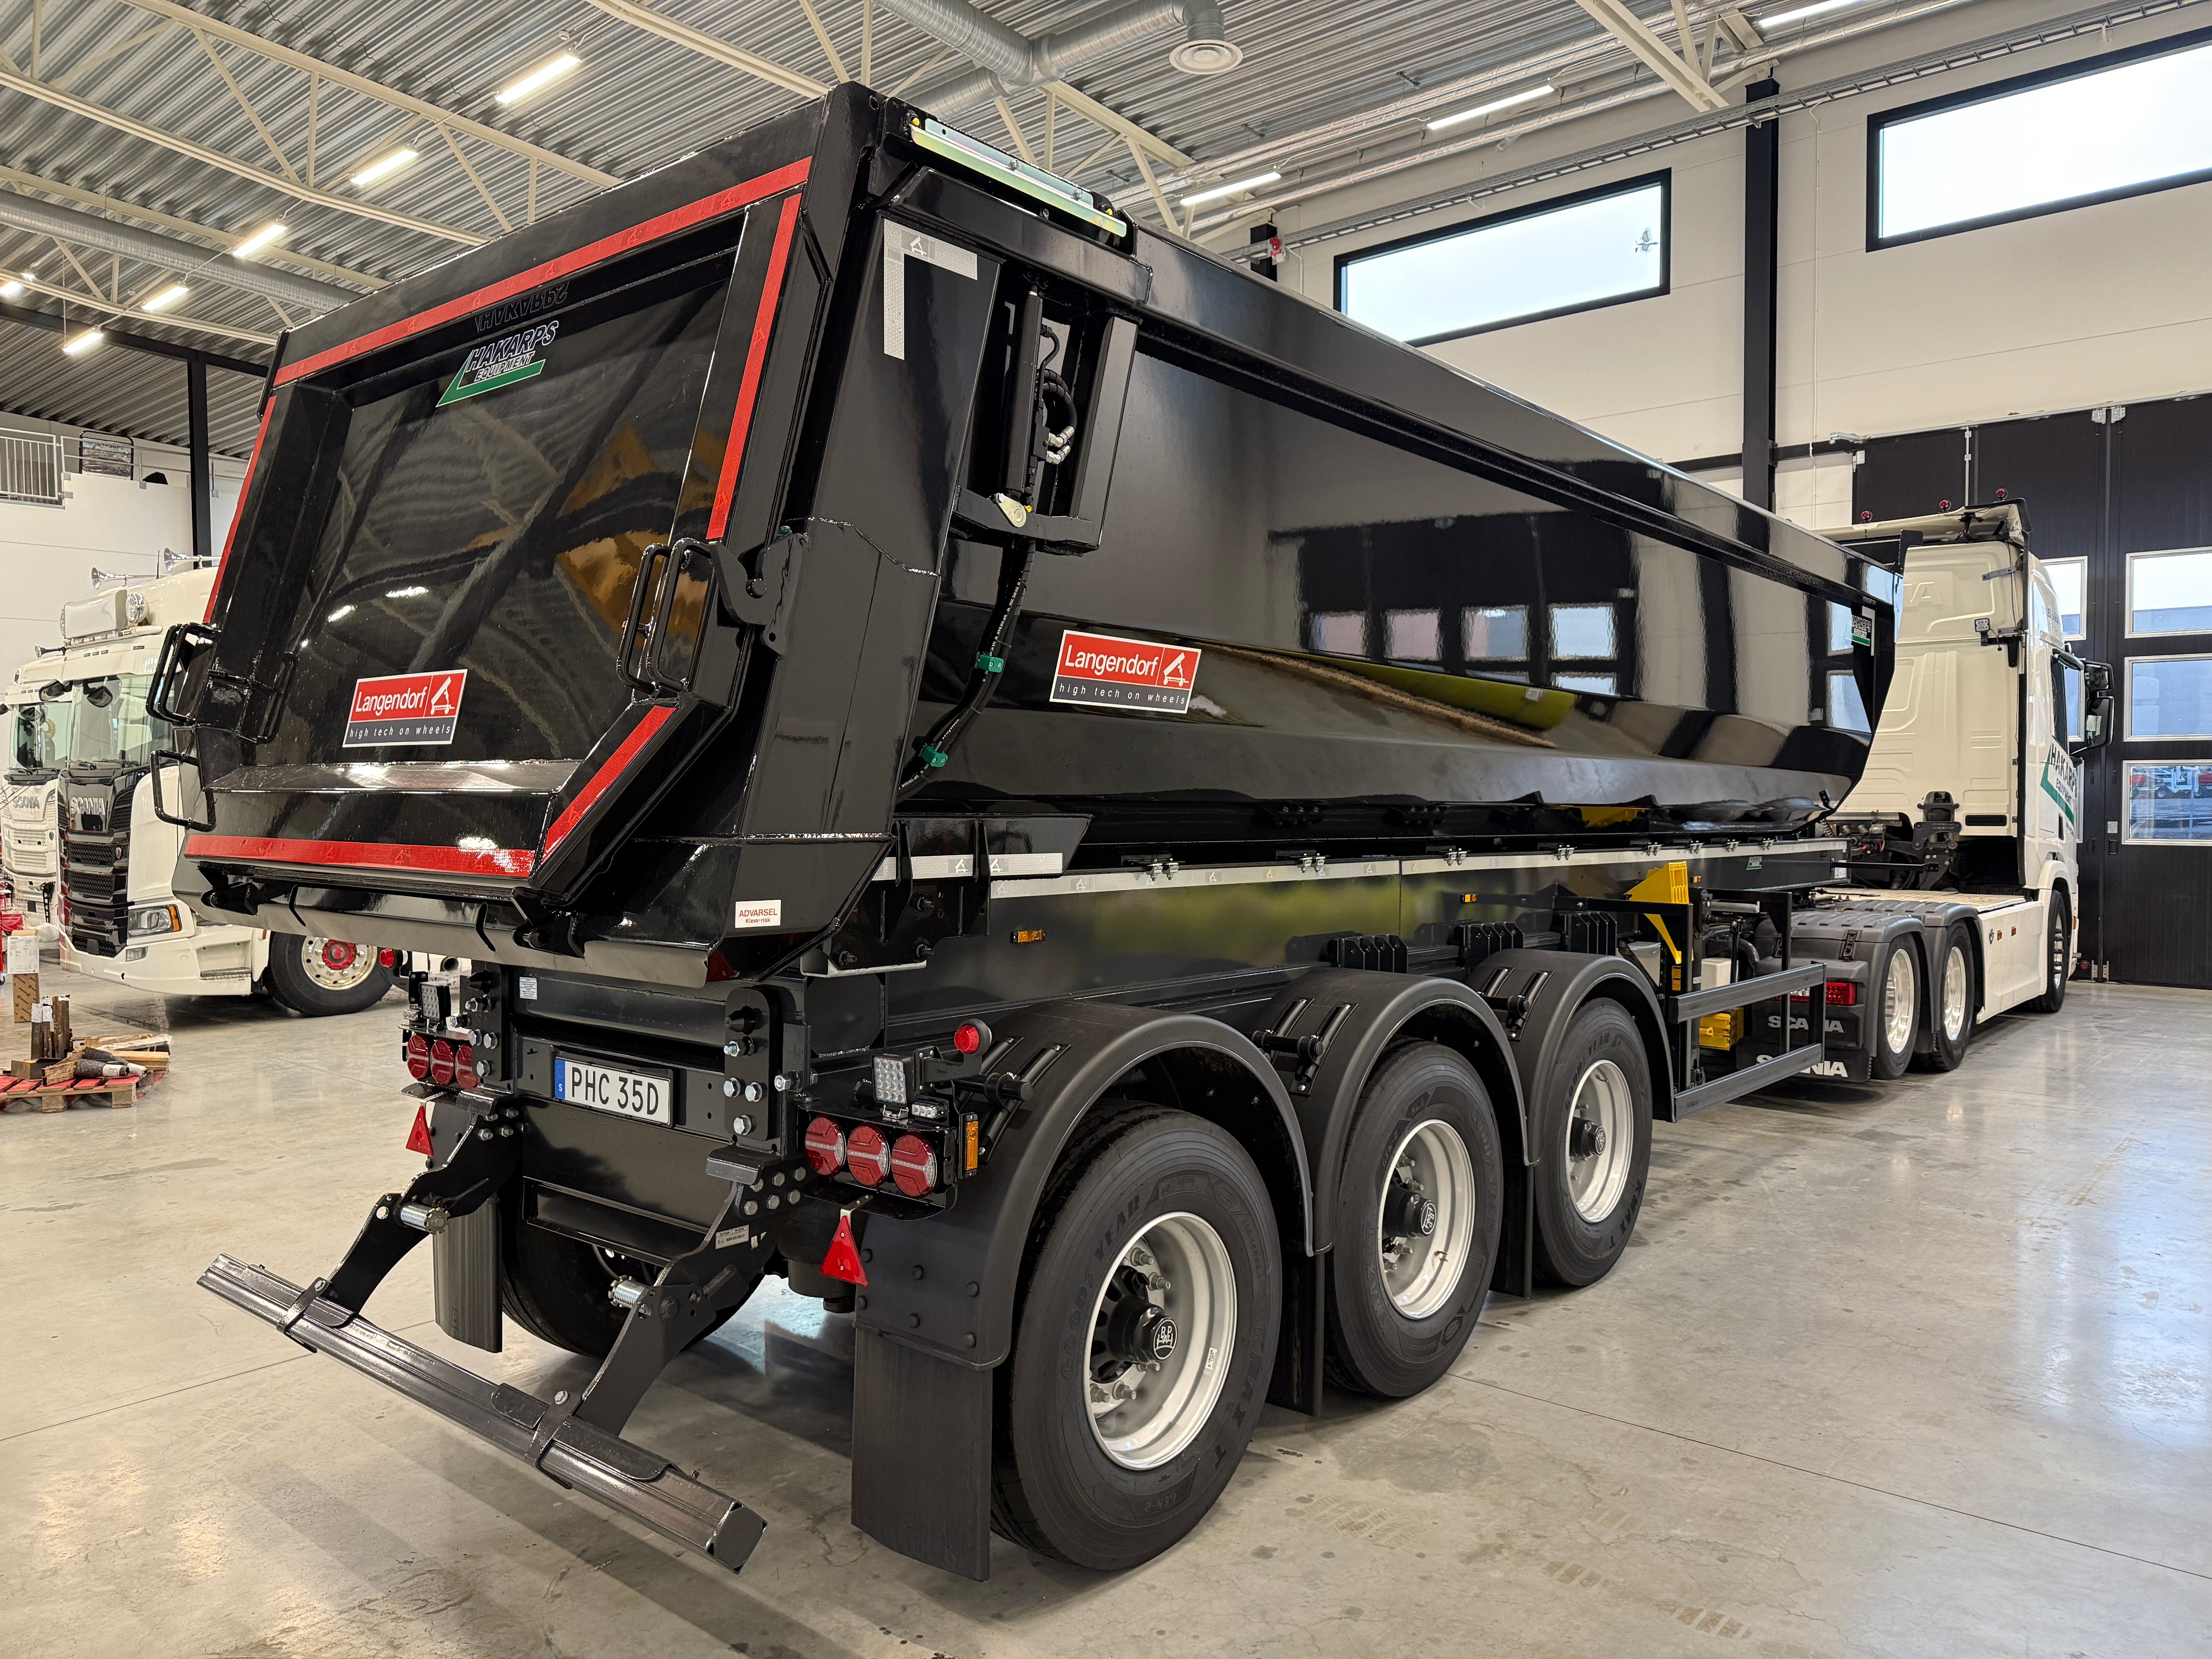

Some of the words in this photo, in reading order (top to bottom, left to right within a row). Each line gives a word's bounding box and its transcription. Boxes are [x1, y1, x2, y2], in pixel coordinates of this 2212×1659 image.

[465, 320, 559, 373] HAKARPS
[474, 350, 536, 382] EQUIPMENT
[1065, 644, 1159, 677] Langendorf
[356, 686, 427, 716] Langendorf
[1059, 683, 1085, 696] high
[1094, 687, 1120, 698] tech
[1148, 693, 1185, 704] wheels
[349, 728, 368, 739] high
[374, 726, 393, 736] tech
[399, 727, 409, 735] on
[416, 724, 450, 735] wheels
[70, 797, 106, 816] SCANIA
[739, 908, 777, 917] ADVARSEL
[1768, 1015, 1844, 1033] SAIA
[1756, 1054, 1848, 1078] SNIA
[559, 1083, 563, 1092] S
[572, 1066, 610, 1104] PHC
[617, 1076, 659, 1115] 35D
